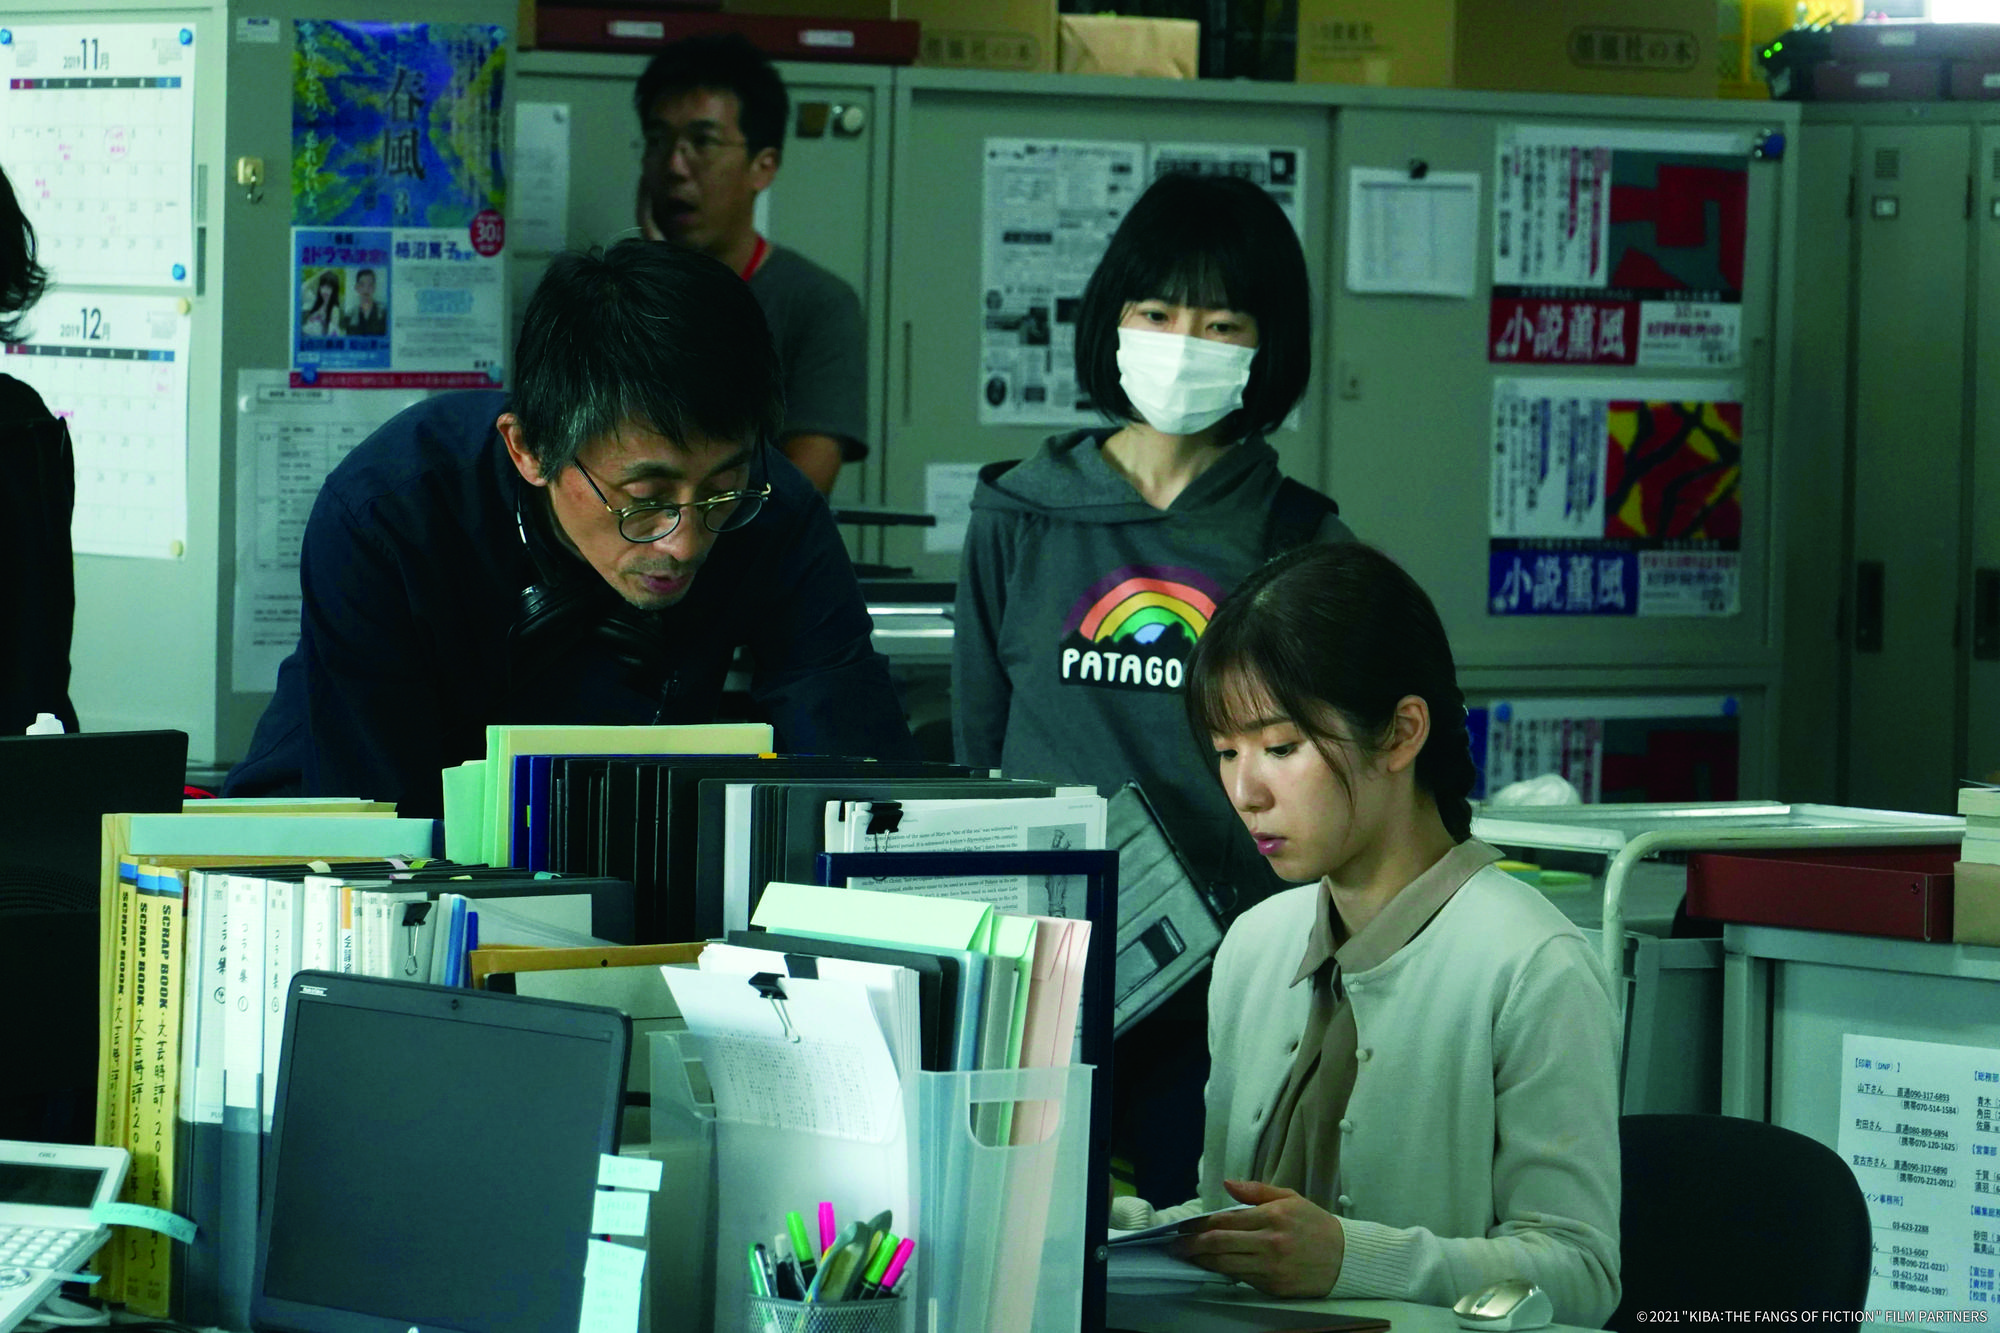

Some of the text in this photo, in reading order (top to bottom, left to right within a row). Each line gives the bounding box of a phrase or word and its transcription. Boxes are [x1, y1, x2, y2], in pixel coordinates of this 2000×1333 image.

[1062, 648, 1183, 688] PATAGO
[136, 902, 148, 1006] SCRAP BOOK
[159, 904, 171, 1009] SCRAP BOOK
[1857, 1082, 1884, 1095] 山下さん
[1855, 1118, 1882, 1132] 町田さん
